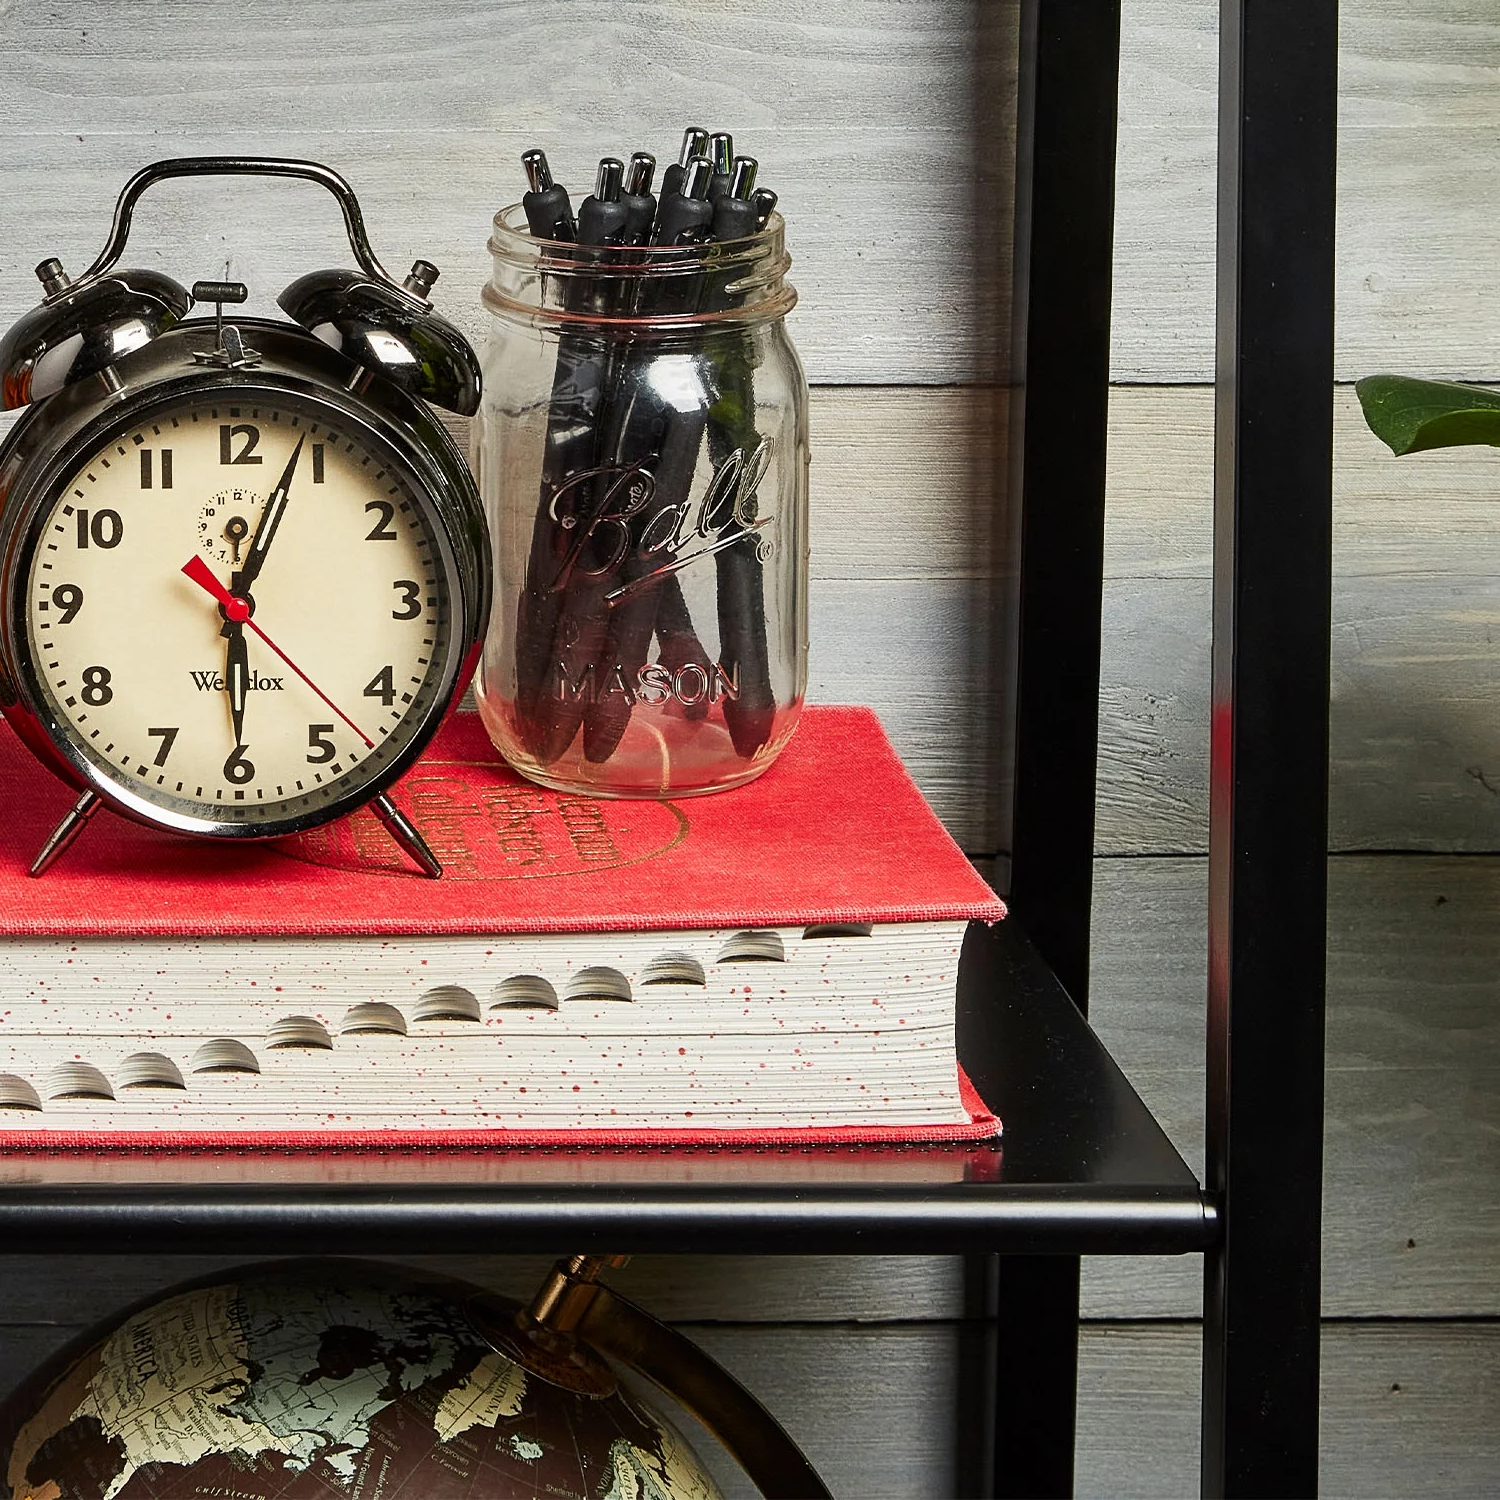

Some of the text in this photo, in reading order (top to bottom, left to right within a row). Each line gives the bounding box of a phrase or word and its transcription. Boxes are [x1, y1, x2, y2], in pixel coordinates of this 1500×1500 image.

[219, 424, 264, 466] 12
[311, 444, 325, 484] 1
[140, 448, 173, 489] 11
[233, 492, 242, 501] 12
[76, 508, 123, 549] 10
[364, 500, 398, 541] 2
[549, 433, 775, 607] Ball
[52, 583, 84, 624] 9
[391, 580, 422, 621] 3
[80, 665, 113, 706] 8
[363, 665, 397, 706] 4
[558, 660, 741, 706] MASON
[147, 727, 180, 767] 7
[223, 744, 256, 785] 6
[306, 724, 337, 764] 5
[555, 796, 629, 862] erriam
[226, 1299, 256, 1347] NORTH
[131, 1323, 159, 1384] AMERICA
[187, 1407, 215, 1446] Washington
[357, 1463, 369, 1485] Found
